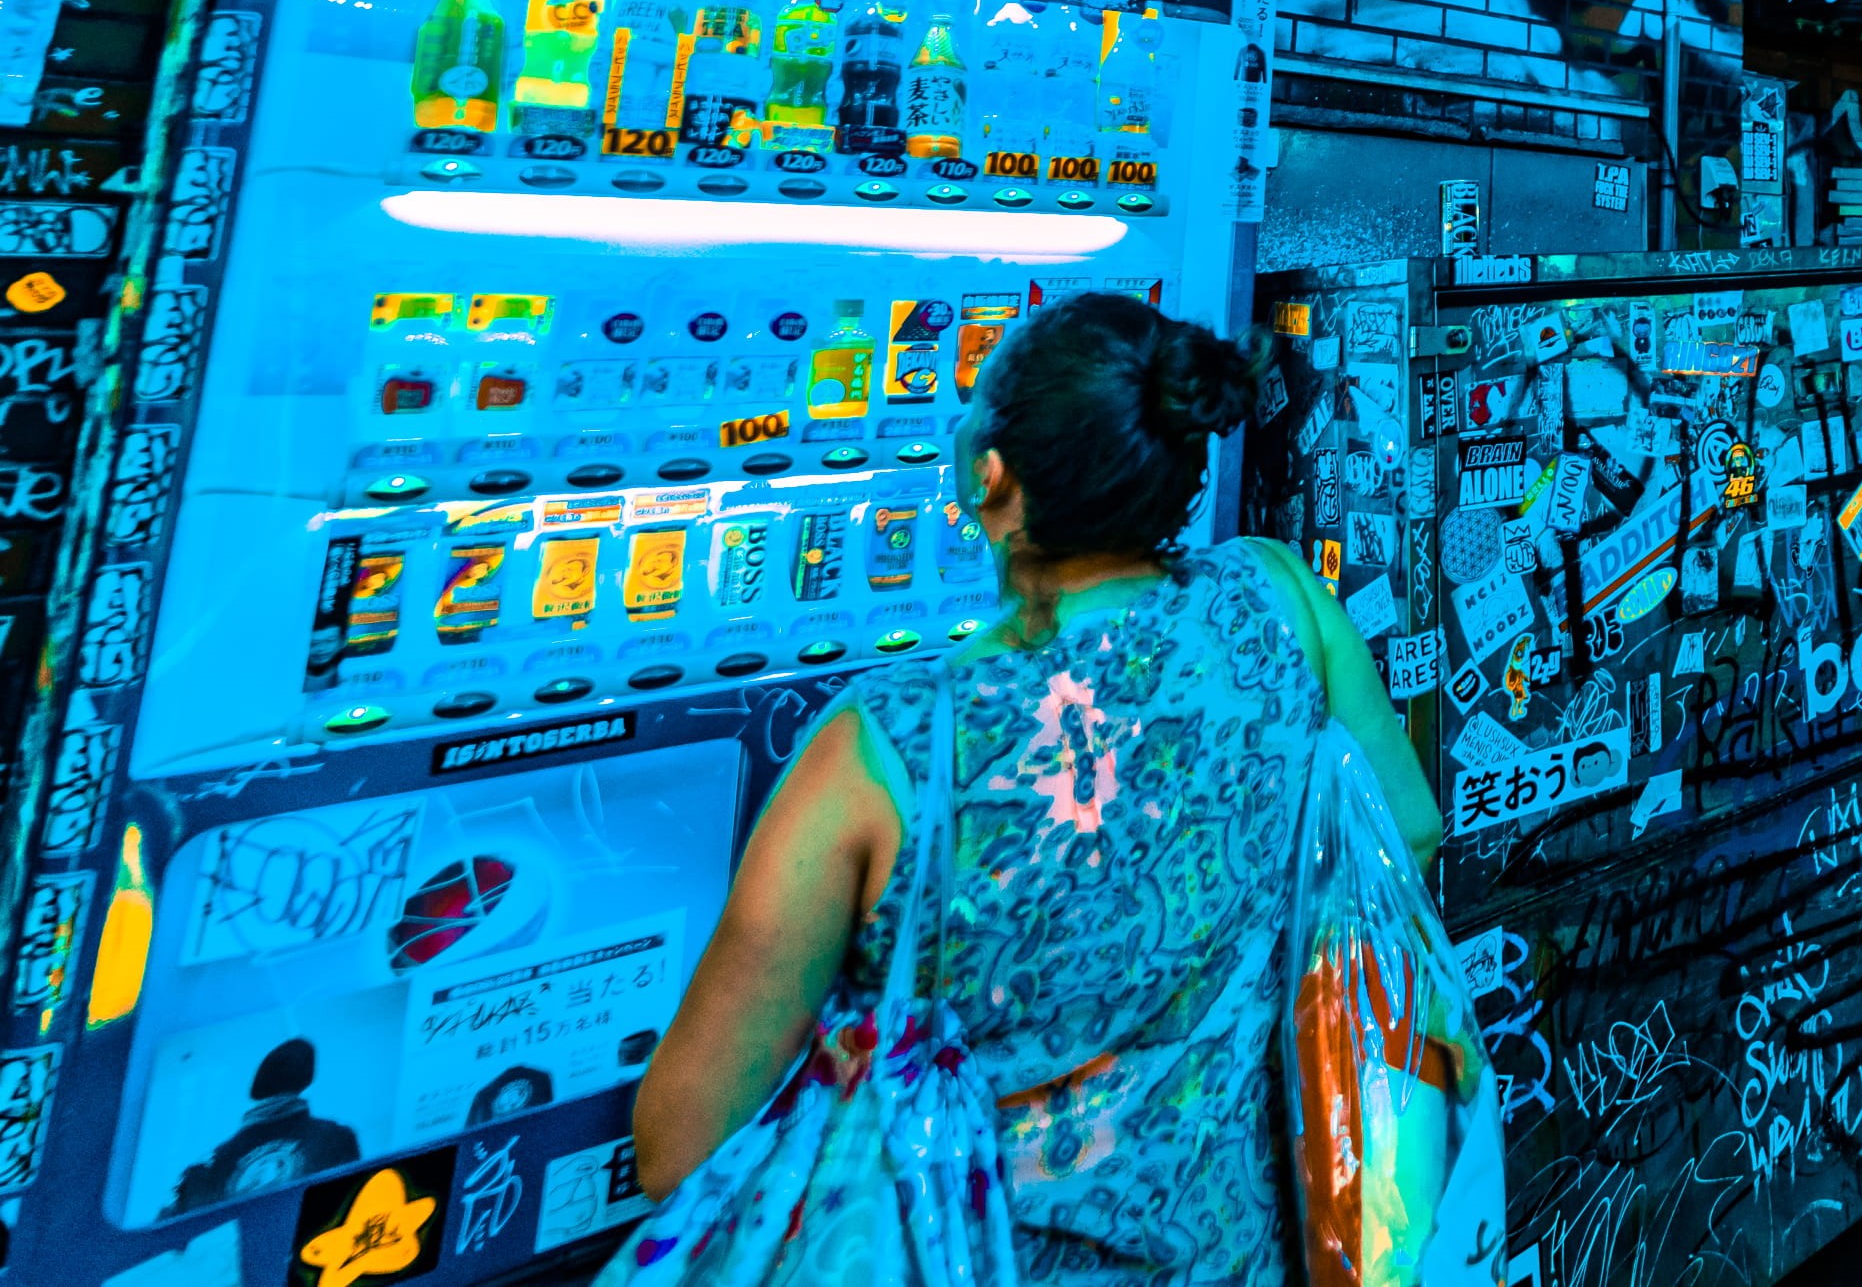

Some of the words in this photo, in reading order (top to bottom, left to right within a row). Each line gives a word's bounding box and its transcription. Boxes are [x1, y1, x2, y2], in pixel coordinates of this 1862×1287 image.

[906, 77, 929, 128] 麦茶
[931, 76, 950, 126] やさしい
[1453, 183, 1479, 257] BLACK
[1594, 195, 1628, 212] SYSTEM
[1441, 376, 1456, 430] OVER
[1466, 441, 1524, 466] BRAIN
[1460, 465, 1525, 505] ALONE
[1725, 476, 1755, 498] 46
[745, 524, 766, 604] BOSS
[1461, 752, 1568, 828] 笑おう
